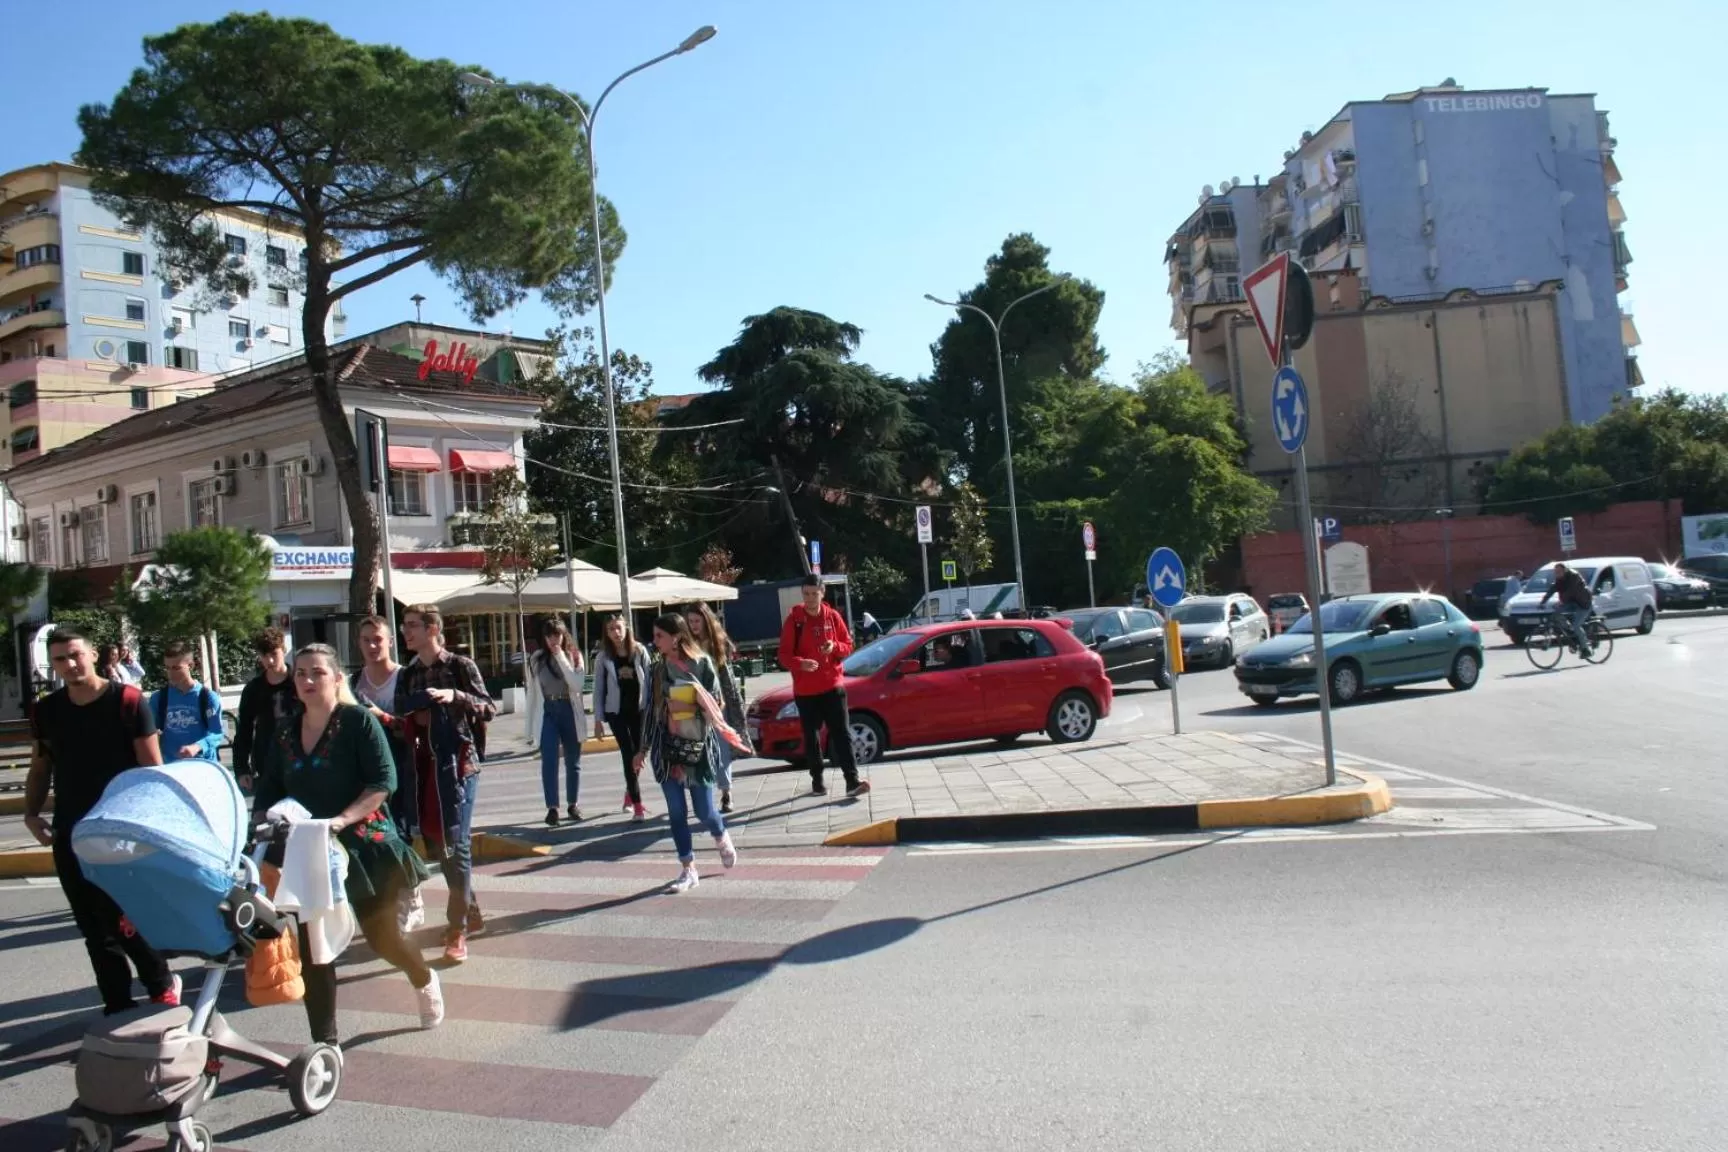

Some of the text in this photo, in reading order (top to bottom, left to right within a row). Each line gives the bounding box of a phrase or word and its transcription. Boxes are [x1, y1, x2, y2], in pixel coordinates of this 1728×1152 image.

[1424, 94, 1542, 112] TELEBINGO
[417, 339, 478, 384] Jolly
[1325, 518, 1337, 534] P
